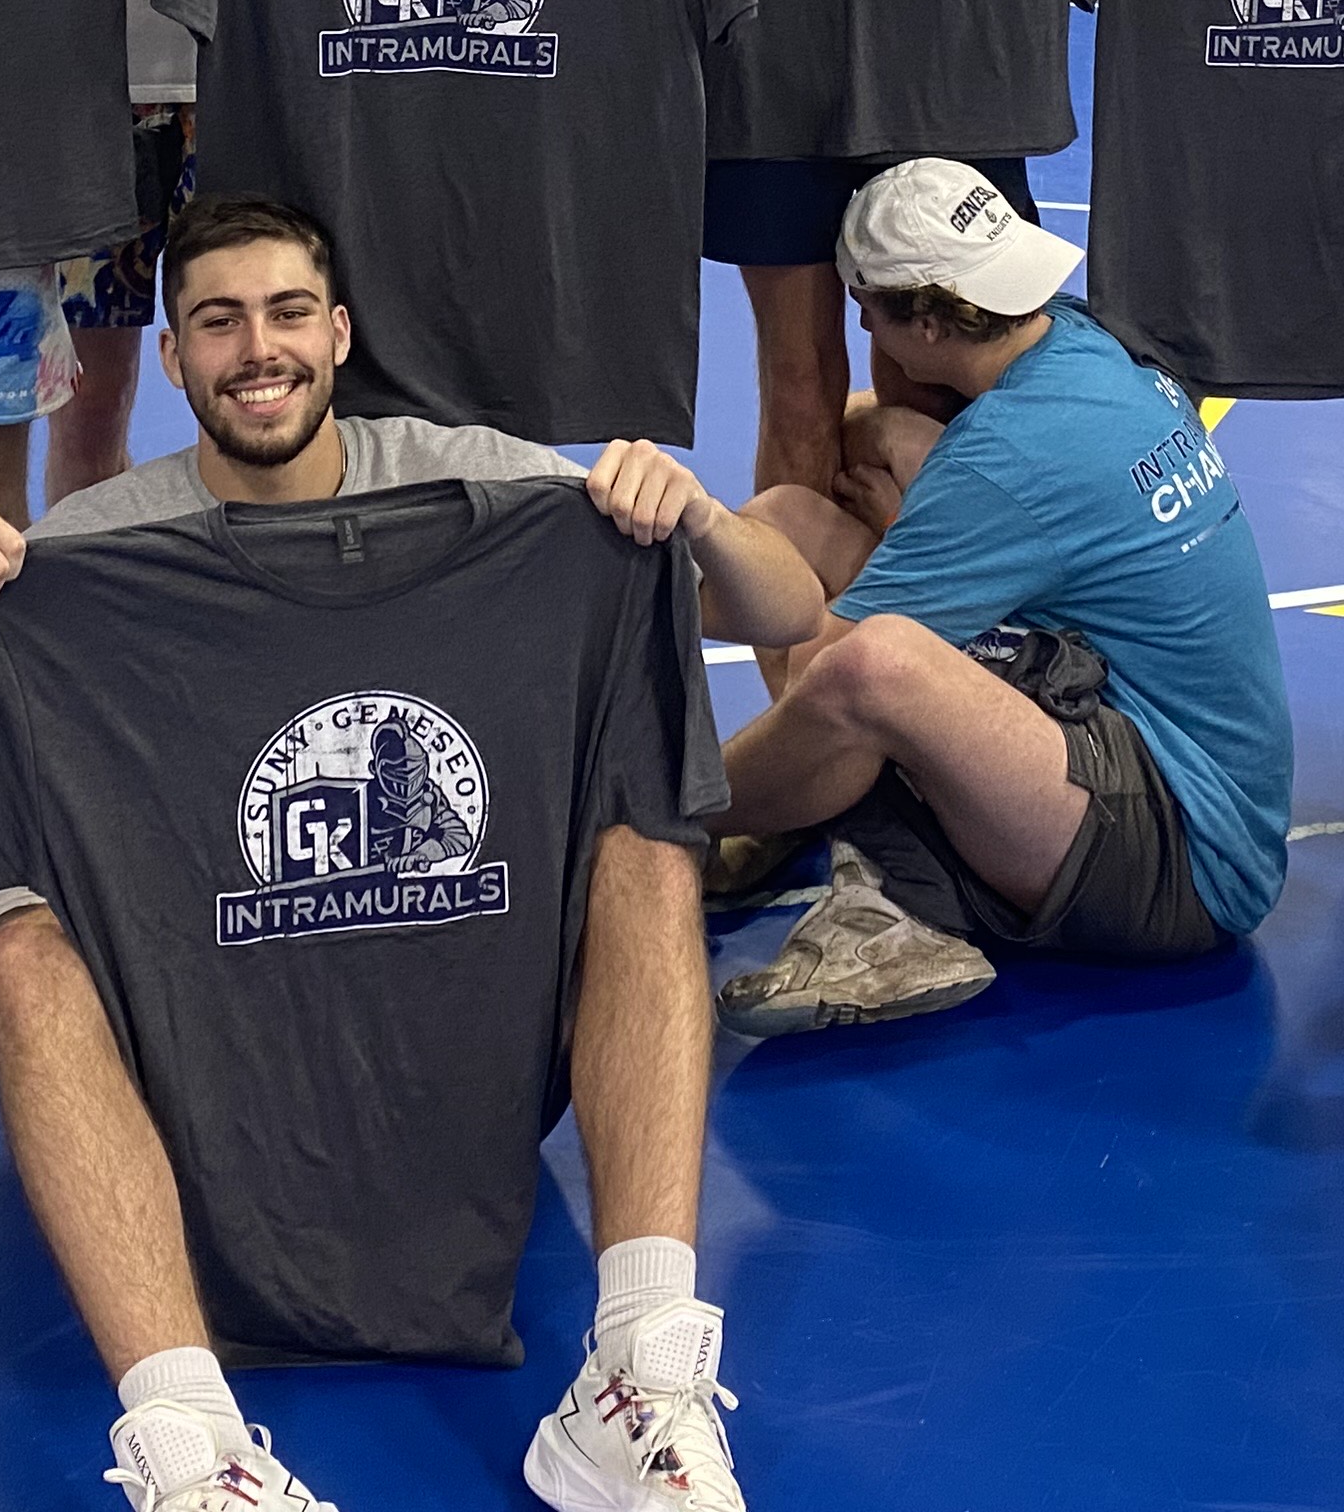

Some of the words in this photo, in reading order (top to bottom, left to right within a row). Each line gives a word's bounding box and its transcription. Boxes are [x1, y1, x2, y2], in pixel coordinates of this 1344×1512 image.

[327, 35, 553, 68] INTRAMURALS
[1129, 415, 1202, 496] INTRA
[247, 724, 310, 822] SUNY
[331, 703, 476, 799] GENESEO
[226, 872, 502, 935] INTRAMURALS
[692, 1324, 715, 1381] MMXX
